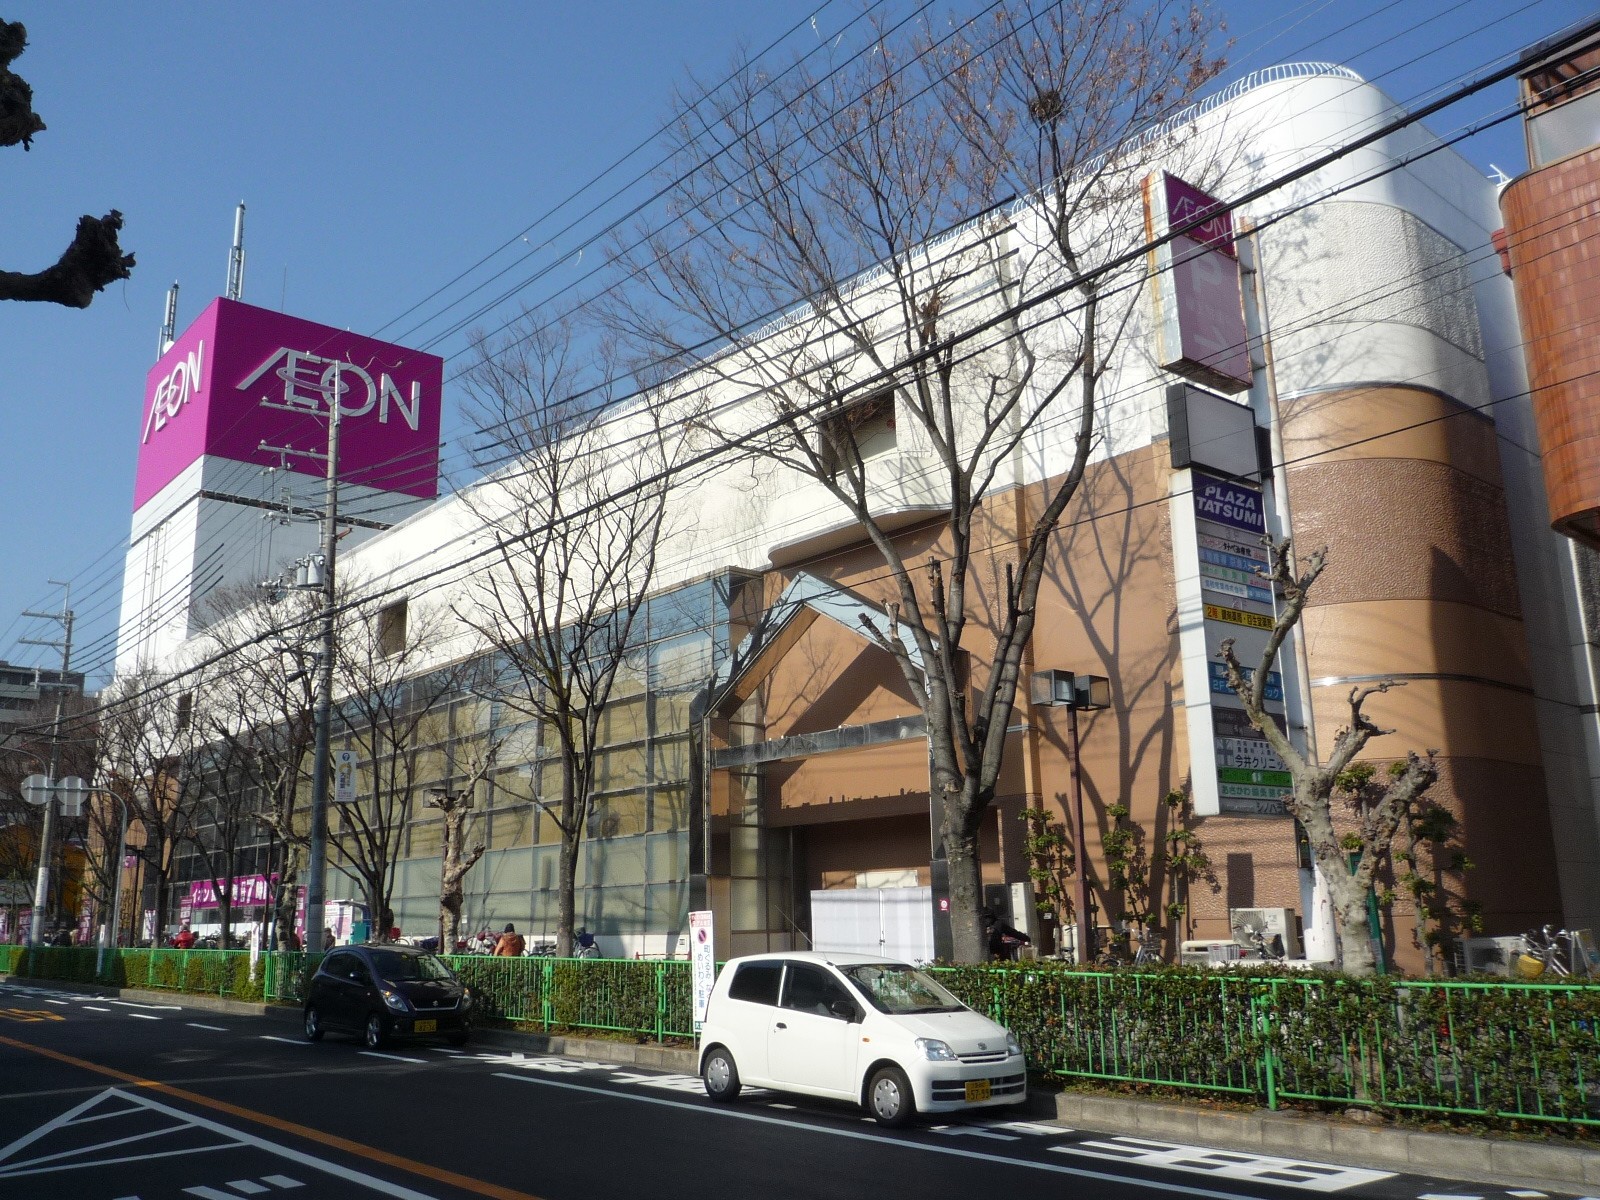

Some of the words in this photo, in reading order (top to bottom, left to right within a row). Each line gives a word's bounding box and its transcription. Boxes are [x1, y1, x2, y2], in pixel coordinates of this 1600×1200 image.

[1172, 196, 1229, 242] AEON
[142, 340, 204, 444] AEON
[236, 346, 421, 431] AEON
[1196, 496, 1262, 526] TATSUMI
[1205, 486, 1255, 510] PLAZA
[1212, 680, 1224, 691] 2F
